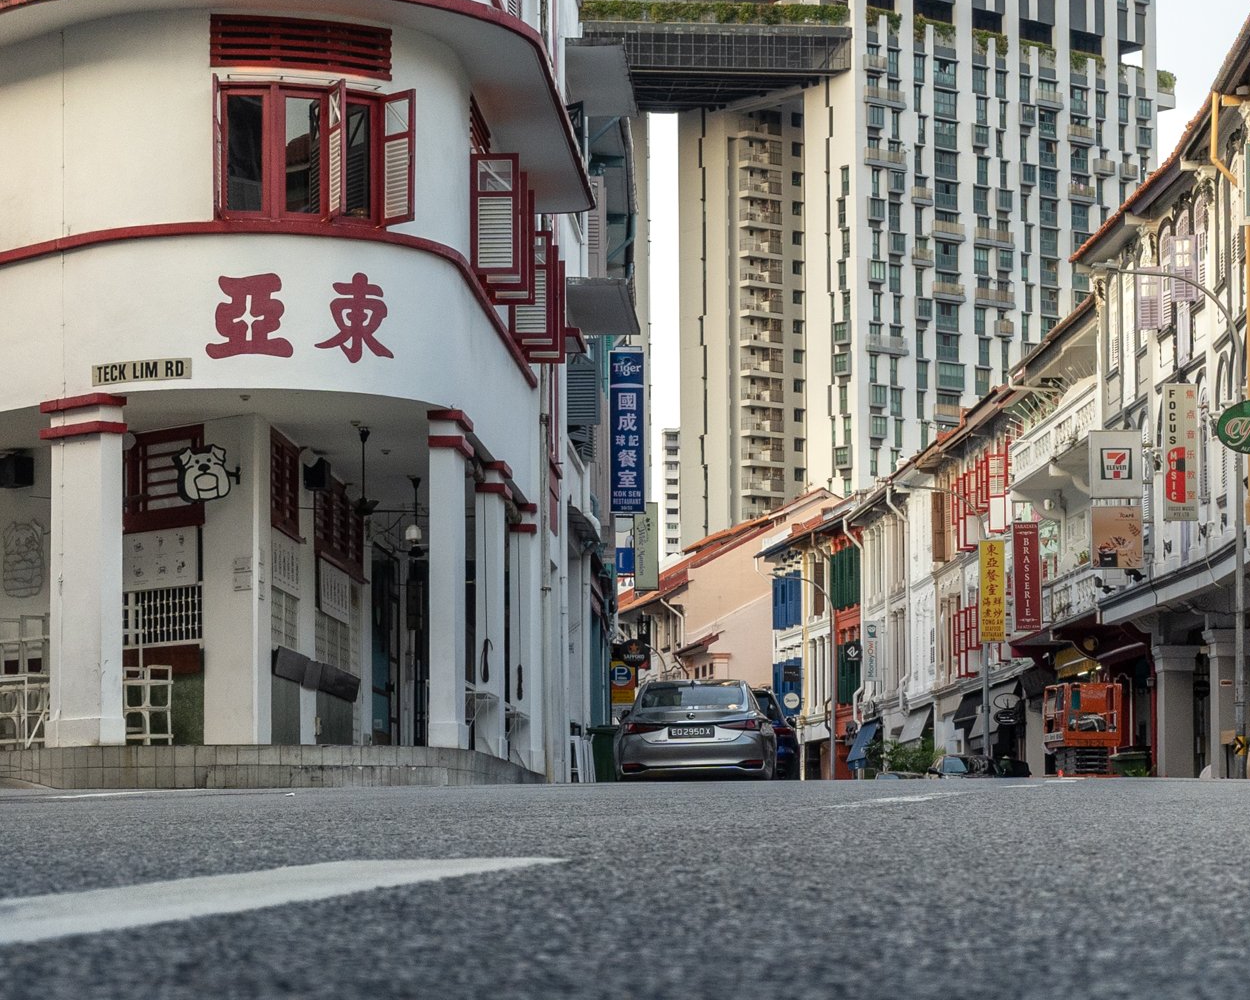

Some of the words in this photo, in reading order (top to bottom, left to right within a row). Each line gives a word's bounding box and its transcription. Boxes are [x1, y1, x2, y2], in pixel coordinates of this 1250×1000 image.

[96, 363, 127, 383] TECK
[132, 361, 158, 380] LIM
[165, 360, 184, 378] RD
[613, 359, 642, 377] Tiger
[1168, 389, 1177, 445] FOCUS
[1106, 452, 1126, 478] 7
[1169, 451, 1178, 500] MUSIC
[613, 490, 627, 498] KOK
[628, 490, 641, 498] SEN
[1023, 537, 1031, 616] BRASSERIE
[867, 640, 876, 678] MoneyOwl
[615, 666, 628, 681] P
